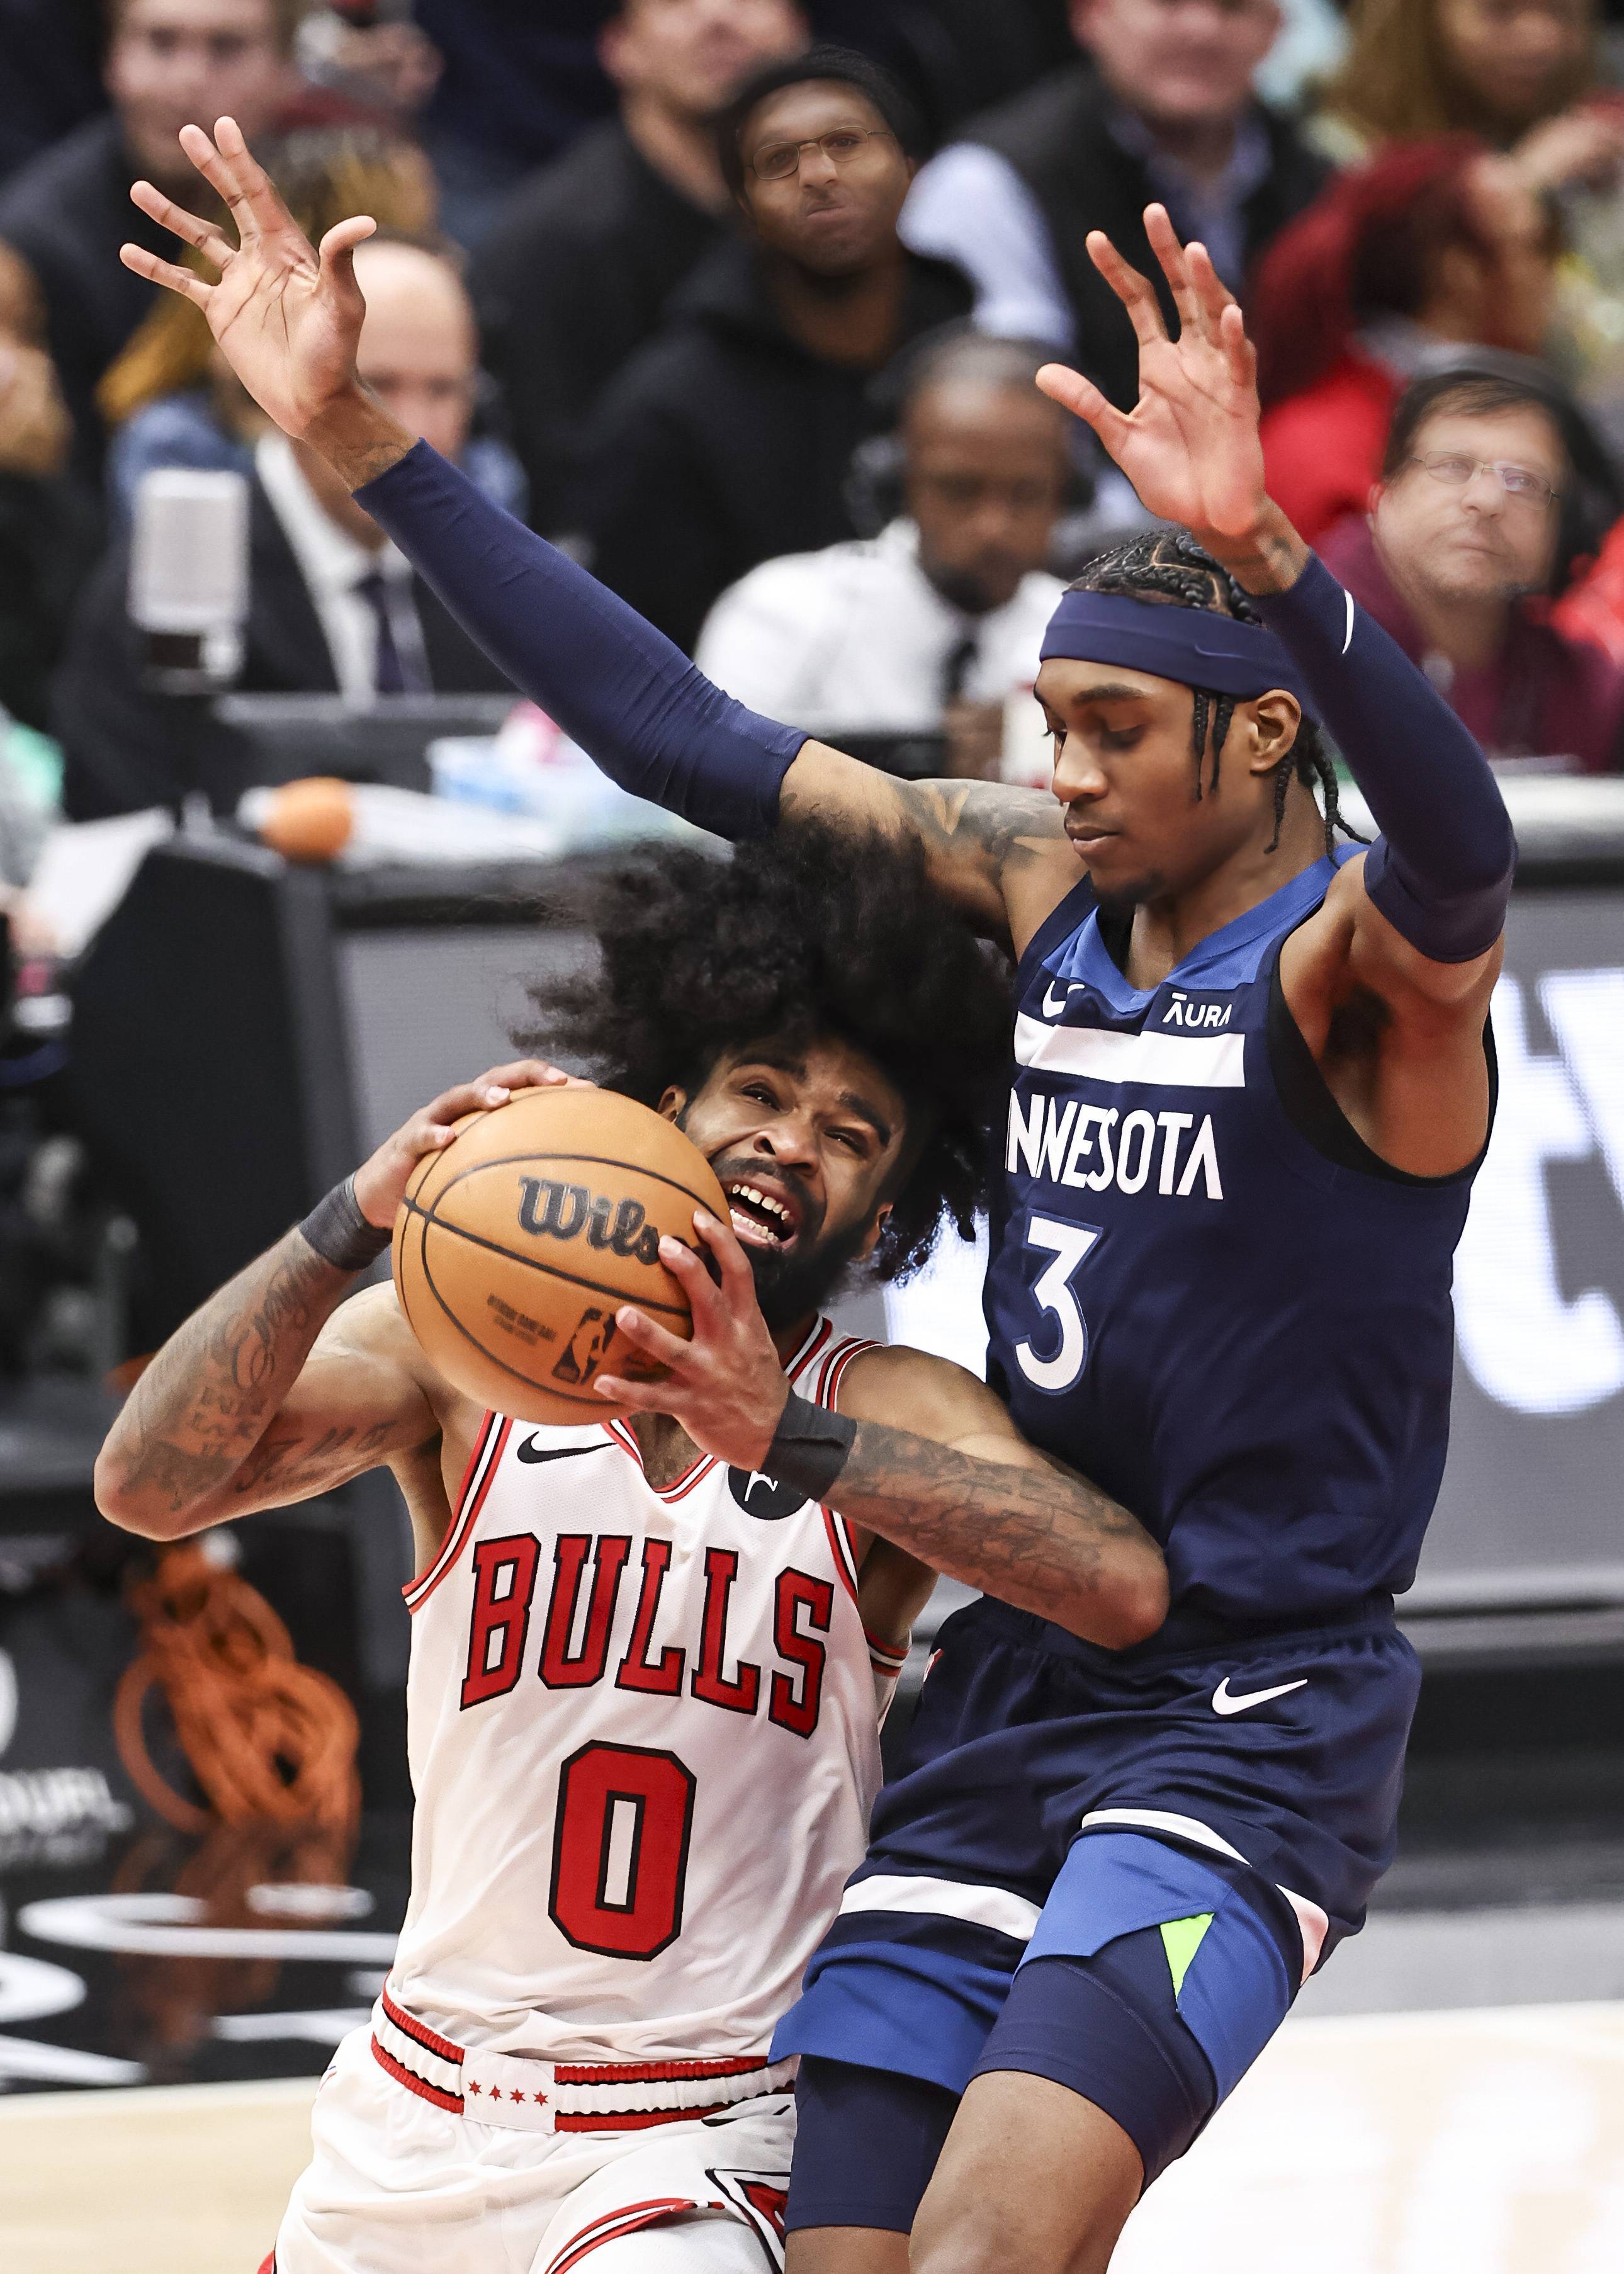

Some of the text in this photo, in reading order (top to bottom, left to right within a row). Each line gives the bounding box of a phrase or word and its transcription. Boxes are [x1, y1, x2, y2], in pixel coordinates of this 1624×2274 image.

[518, 1175, 690, 1265] Wils
[1013, 1208, 1103, 1395] 3
[460, 1532, 834, 1739] BULLS
[548, 1739, 697, 1962] 0
